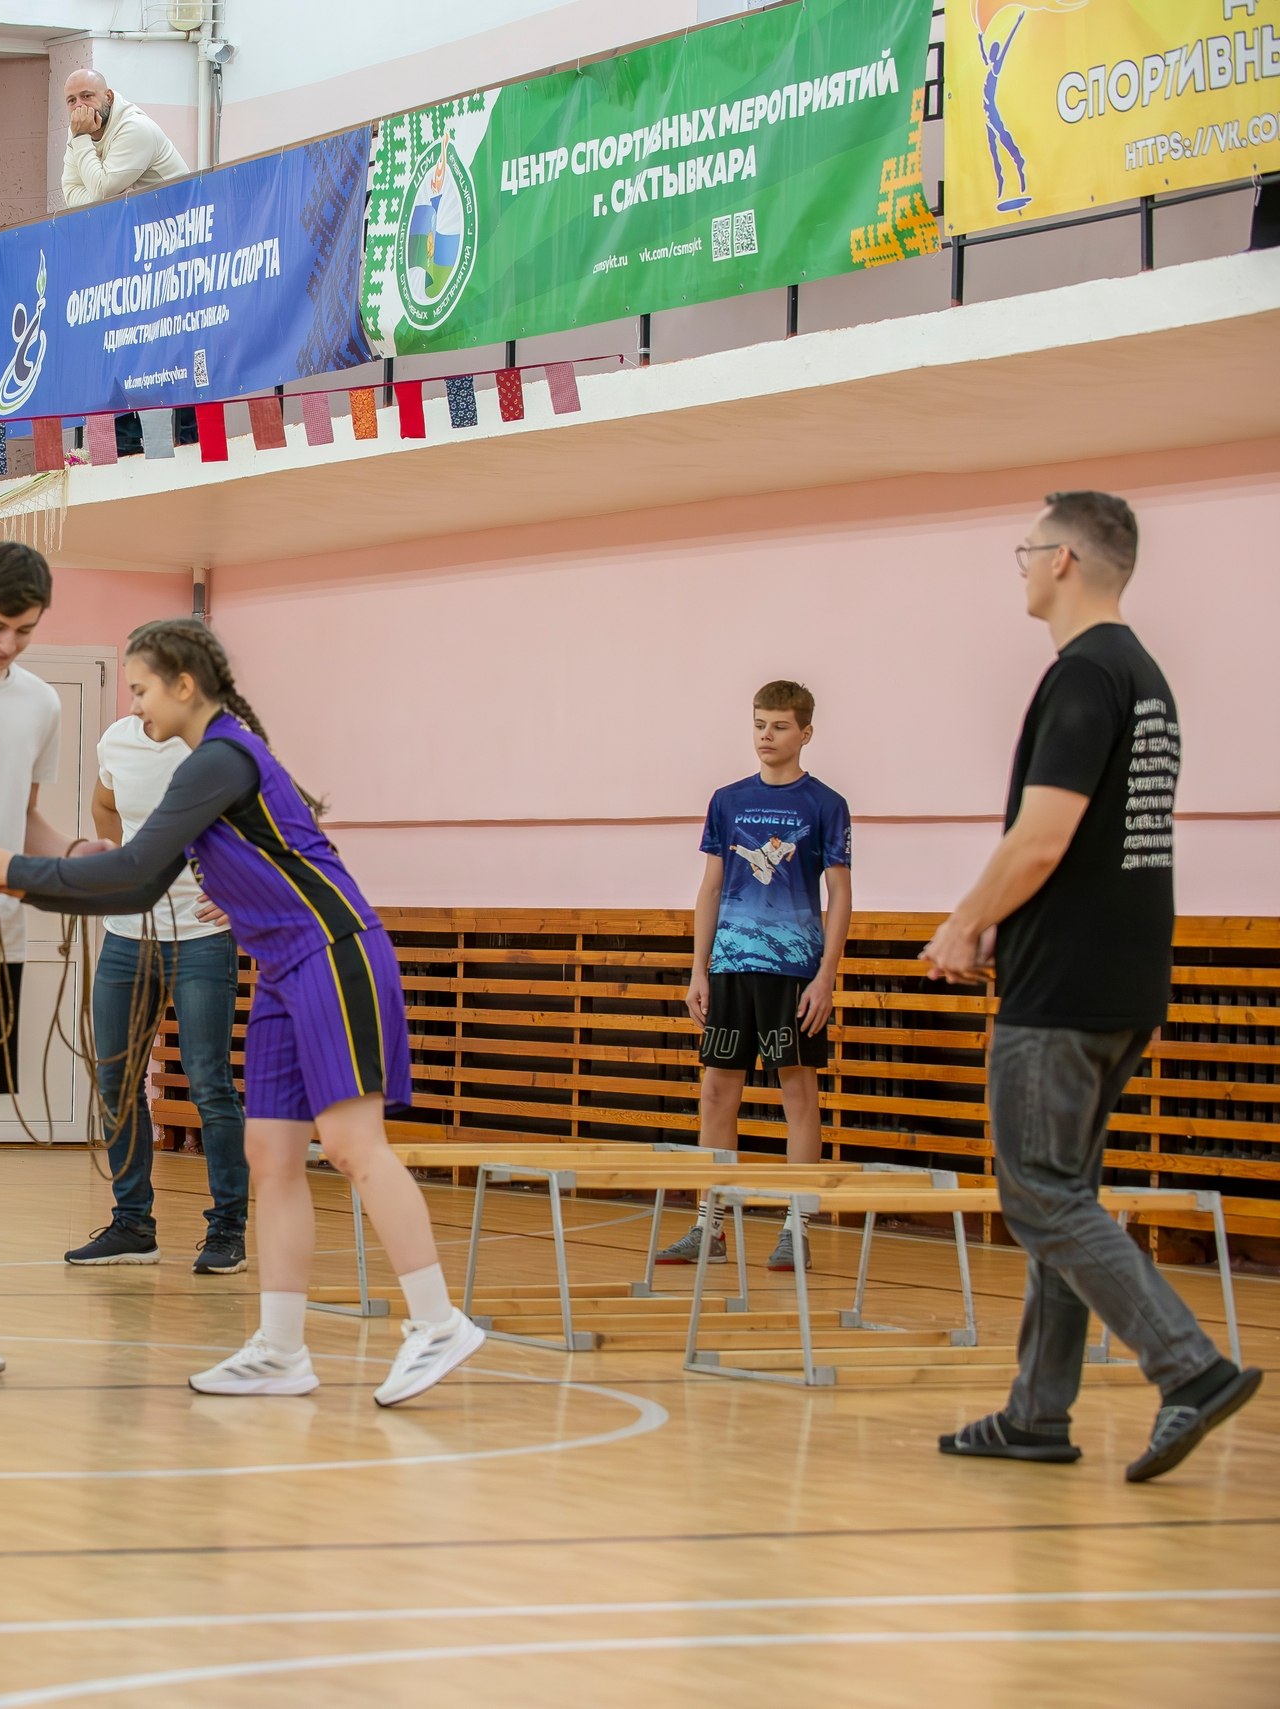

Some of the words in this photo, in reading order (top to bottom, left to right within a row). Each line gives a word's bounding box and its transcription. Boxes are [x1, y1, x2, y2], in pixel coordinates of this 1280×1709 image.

[500, 147, 570, 195] ЦЕНТР
[570, 106, 717, 176] СПОРТИВНЫХ
[718, 48, 900, 136] МЕРОПРИЯТИЙ
[593, 194, 607, 217] г.
[610, 145, 757, 214] СЫКТЫВКАРА
[66, 262, 153, 328] ФИЗИЧЕСКОЙ
[216, 252, 232, 291] И
[231, 237, 281, 289] СПОРТА
[639, 237, 703, 264] vk.com/csmsykt
[734, 813, 804, 827] PROMETEY
